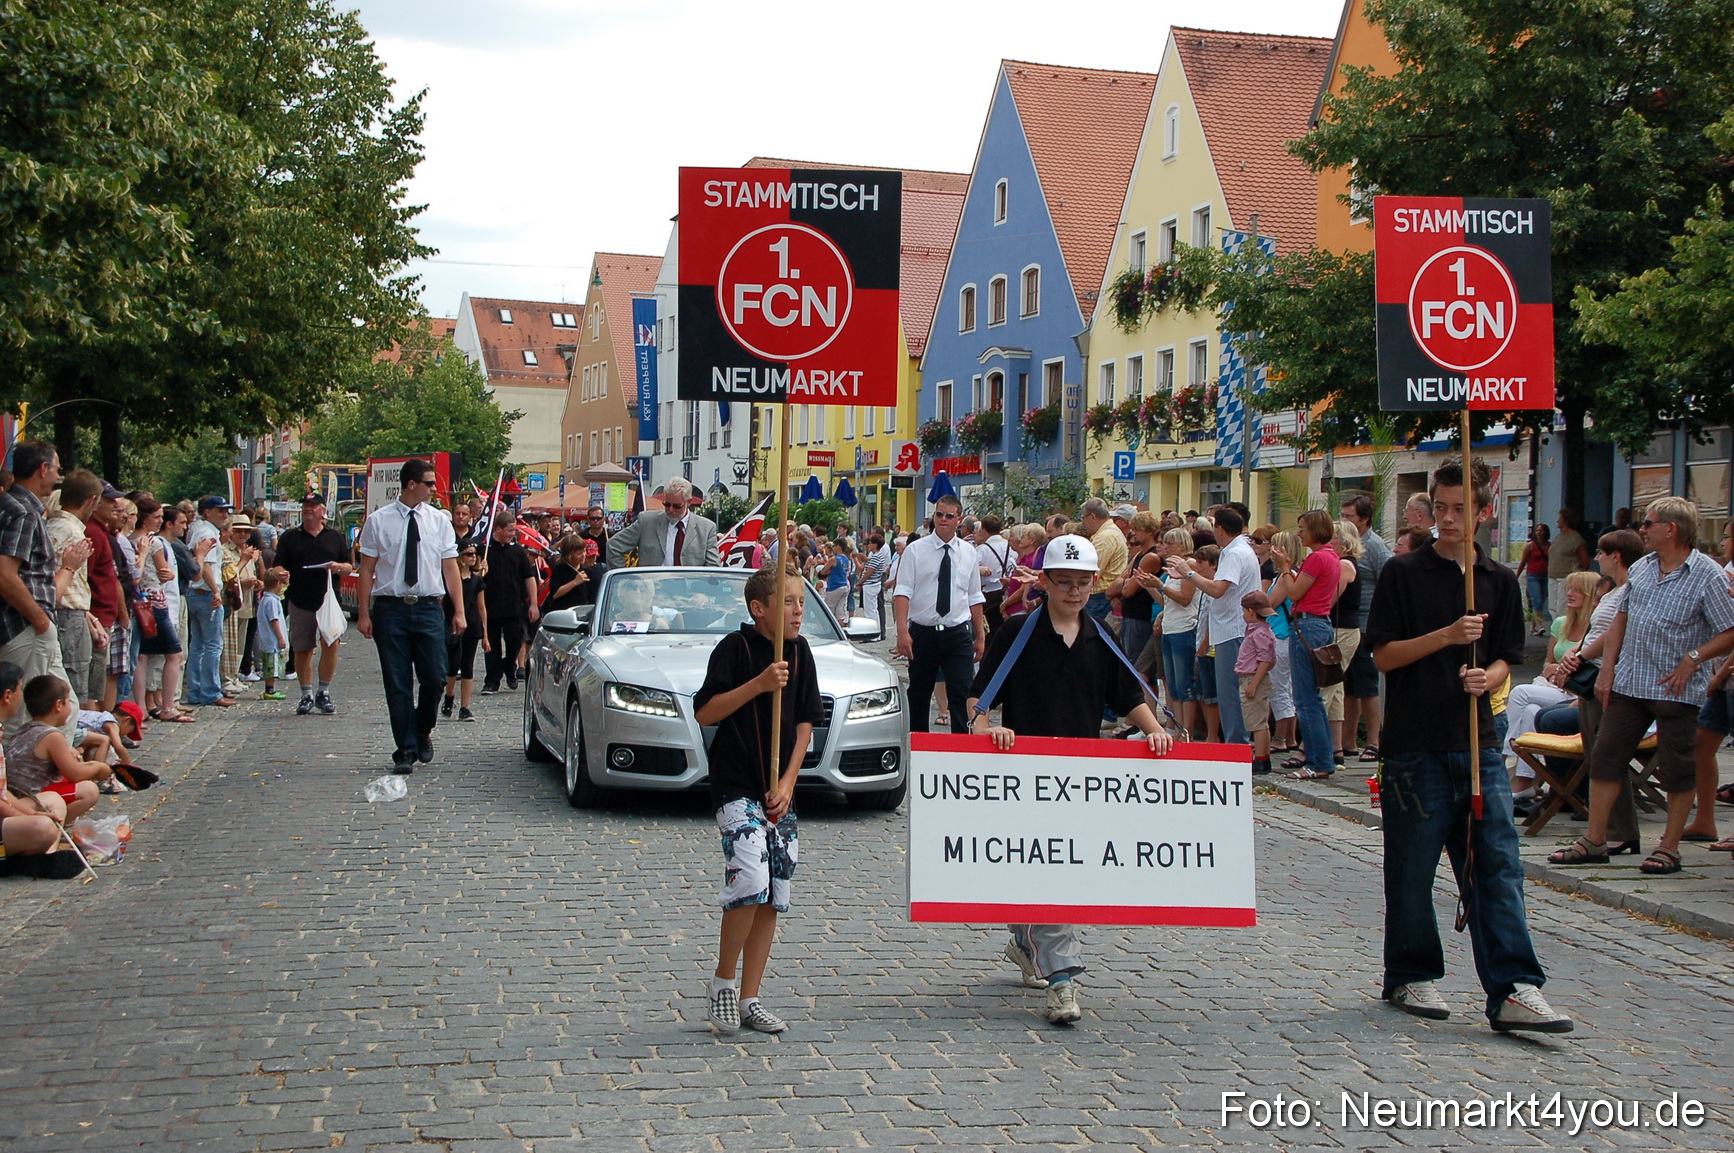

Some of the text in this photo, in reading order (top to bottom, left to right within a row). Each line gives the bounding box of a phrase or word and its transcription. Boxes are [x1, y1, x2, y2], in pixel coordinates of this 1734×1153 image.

[704, 180, 879, 211] STAMMTISCH
[1393, 208, 1533, 235] STAMMTISCH
[769, 236, 800, 279] 1.
[1448, 257, 1475, 296] 1.
[733, 283, 837, 327] FCN
[1421, 300, 1505, 340] FCN
[712, 367, 864, 396] NEUMARKT
[1406, 377, 1527, 402] NEUMARKT
[1298, 411, 1306, 464] KIO
[374, 469, 400, 483] WIR WARE
[1118, 455, 1131, 478] P
[919, 773, 1244, 807] UNSER EX-PRÄSIDENT
[943, 836, 1215, 868] MICHAEL A. ROTH
